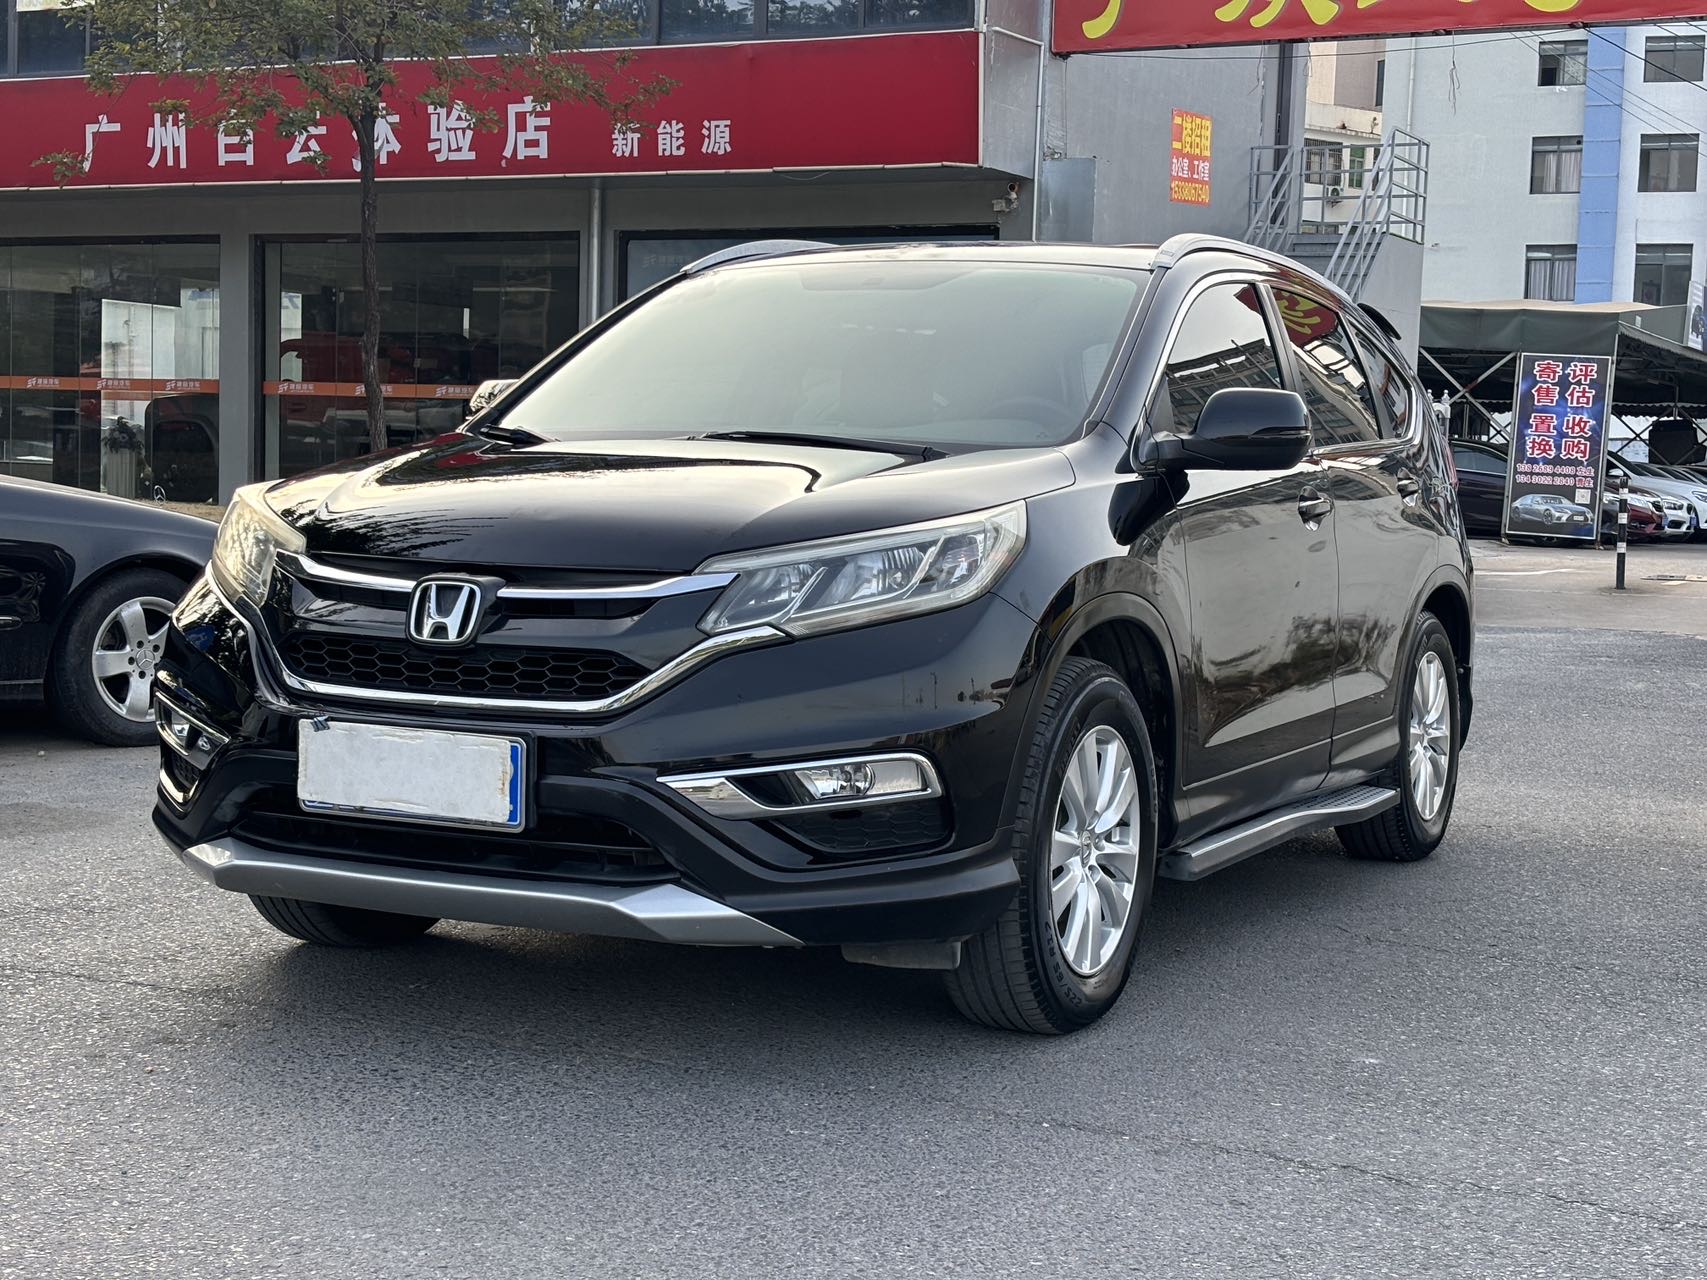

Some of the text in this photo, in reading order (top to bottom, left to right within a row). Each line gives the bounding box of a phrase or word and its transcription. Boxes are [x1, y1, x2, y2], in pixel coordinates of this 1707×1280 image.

[611, 119, 732, 158] 新能源
[1172, 114, 1211, 157] 二楼招租
[1527, 360, 1562, 459] 寄售 置换
[1559, 362, 1597, 461] 评估 收购
